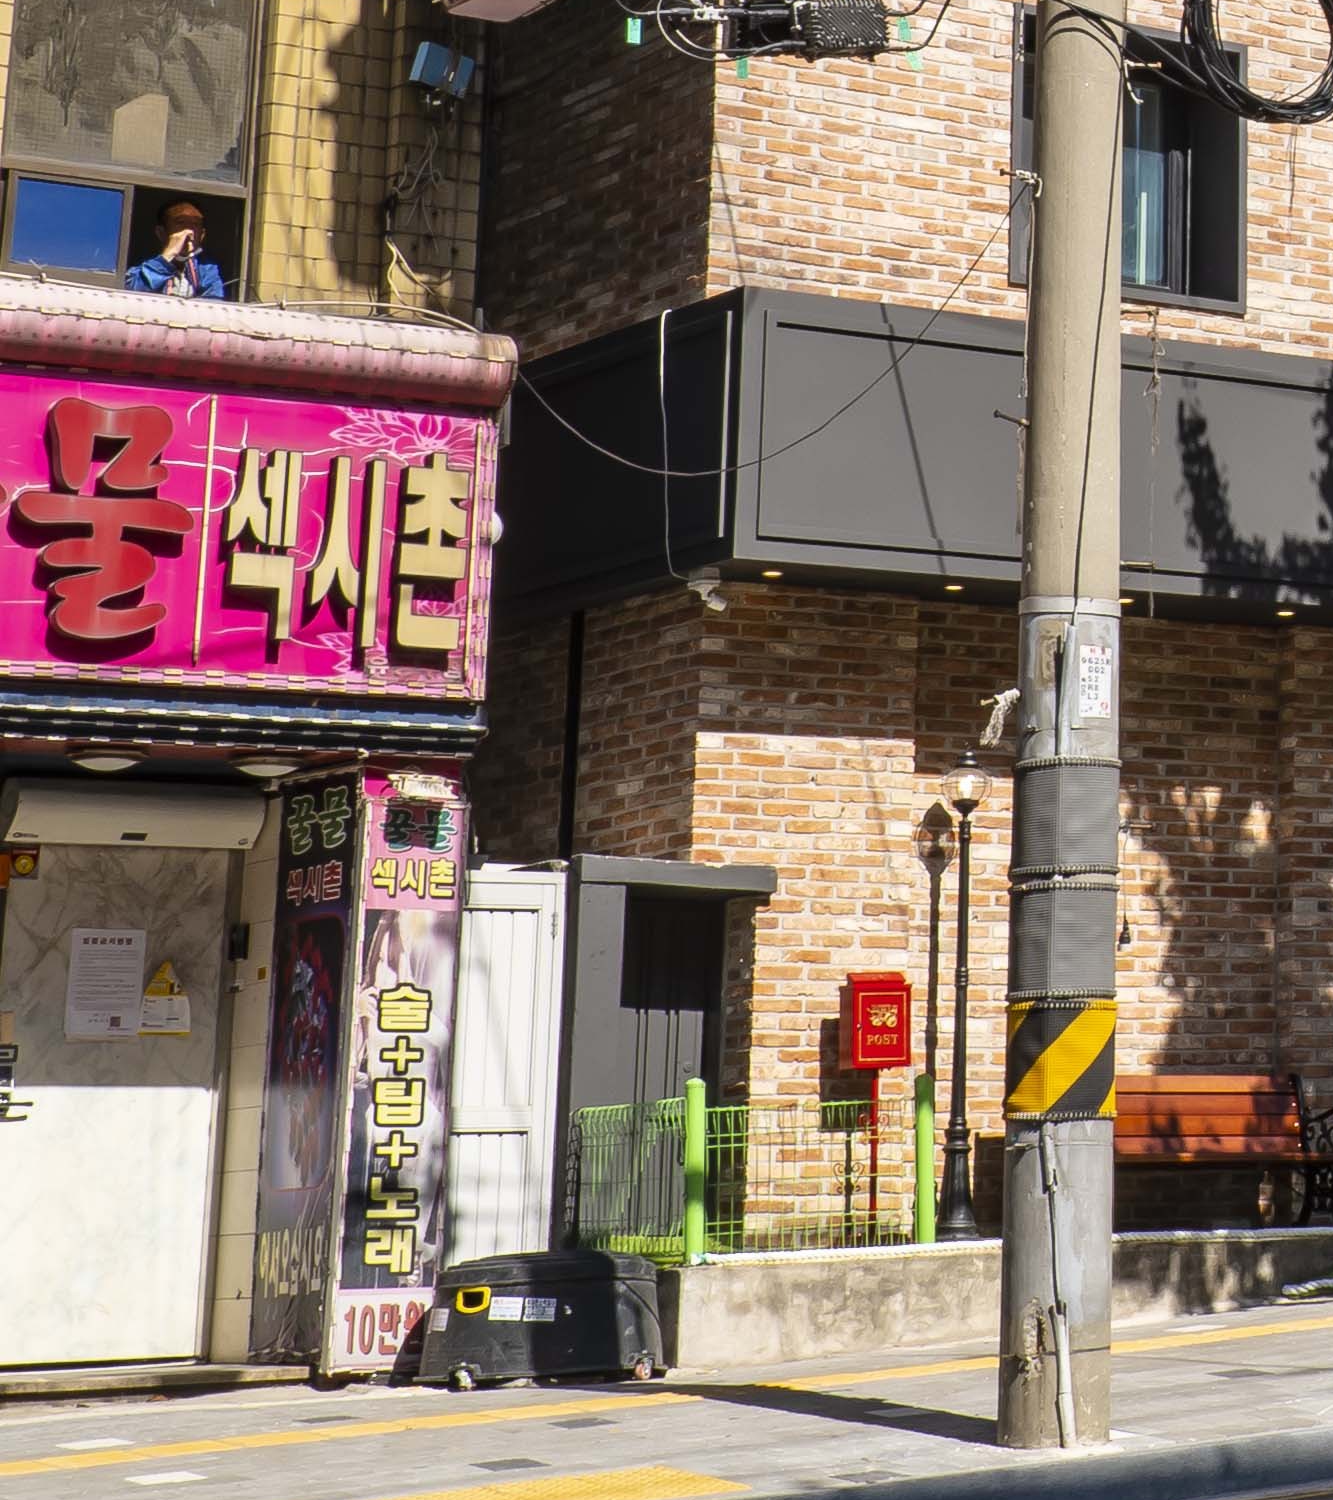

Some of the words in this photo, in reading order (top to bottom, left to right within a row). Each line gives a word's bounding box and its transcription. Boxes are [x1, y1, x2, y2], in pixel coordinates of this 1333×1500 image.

[0, 397, 195, 642] 물
[224, 448, 472, 651] 섹시촌
[287, 785, 351, 855] 꿀물
[379, 806, 458, 853] 꿀물
[286, 860, 343, 906] 섹시촌
[371, 858, 458, 900] 섹시촌
[866, 1033, 899, 1046] POST
